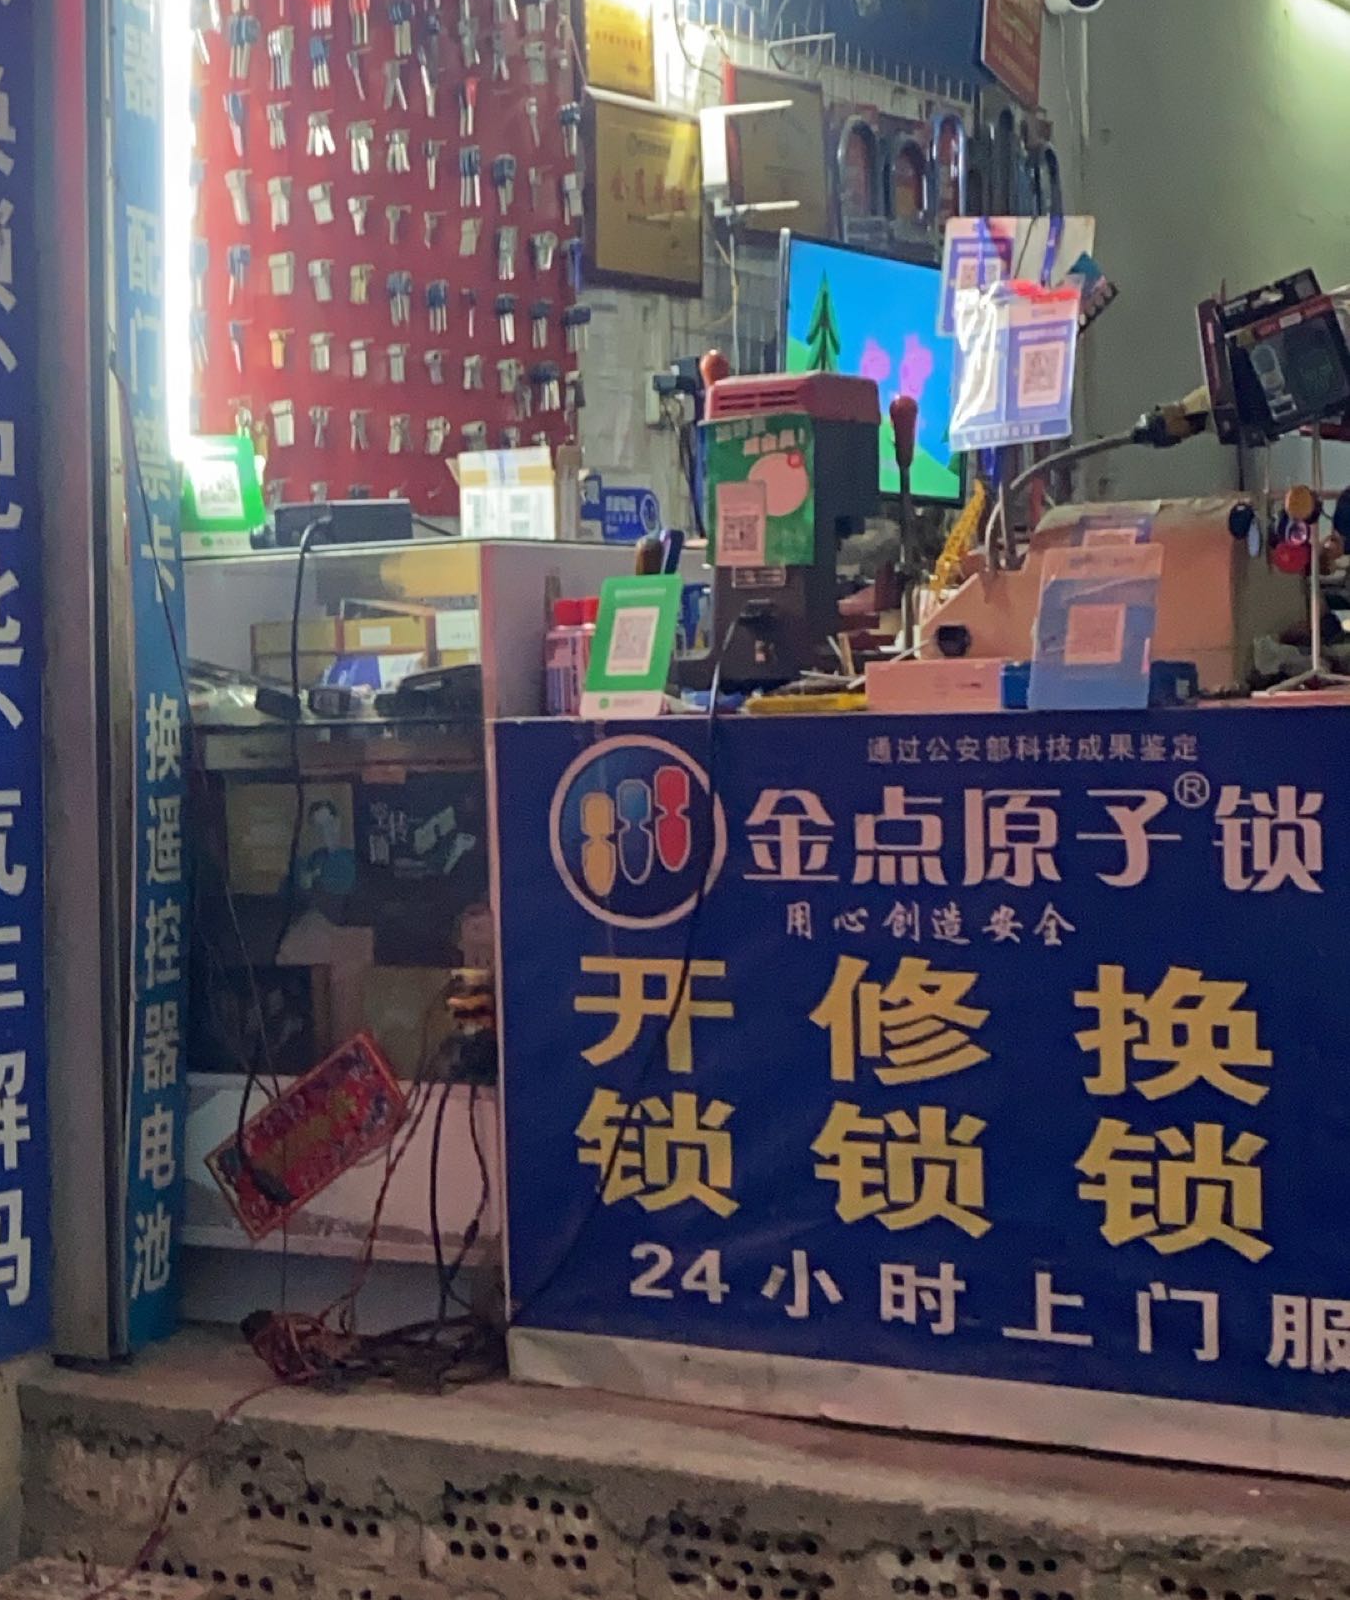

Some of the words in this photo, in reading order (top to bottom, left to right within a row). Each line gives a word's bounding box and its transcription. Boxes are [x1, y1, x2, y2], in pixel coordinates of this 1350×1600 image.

[865, 732, 1200, 765] 通过公安部科技成果鉴定
[784, 900, 1077, 947] 用心创造安全
